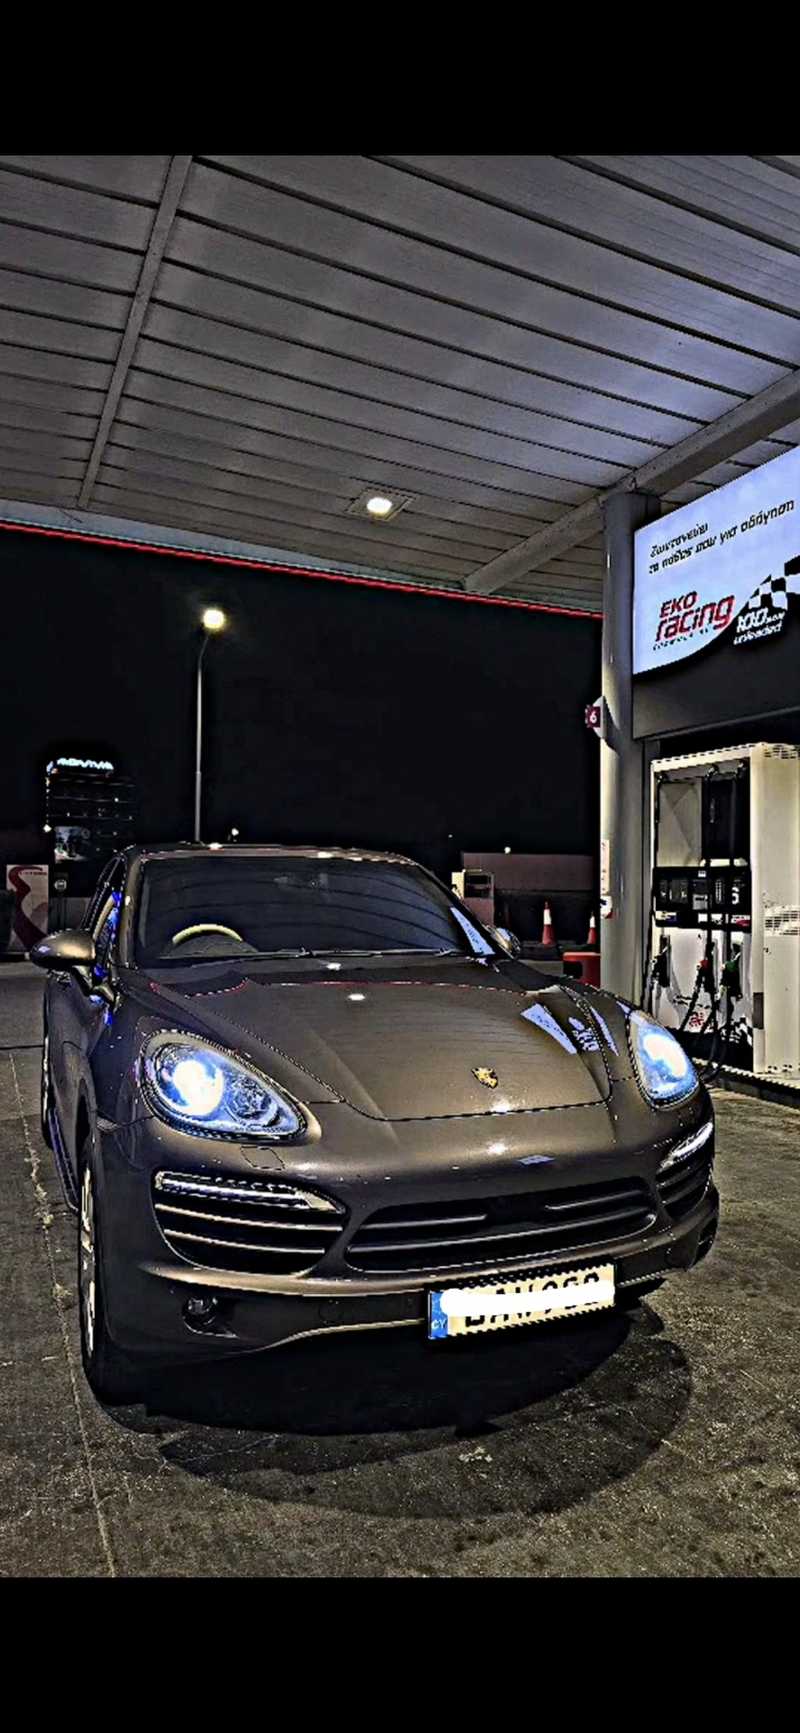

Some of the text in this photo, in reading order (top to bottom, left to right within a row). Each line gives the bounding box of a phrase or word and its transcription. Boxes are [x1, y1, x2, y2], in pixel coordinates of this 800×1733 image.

[720, 526, 738, 545] για
[740, 500, 794, 532] οδήγηση
[659, 591, 698, 618] EKO
[655, 595, 735, 642] racing
[589, 710, 597, 724] 6
[431, 1319, 446, 1330] CY
